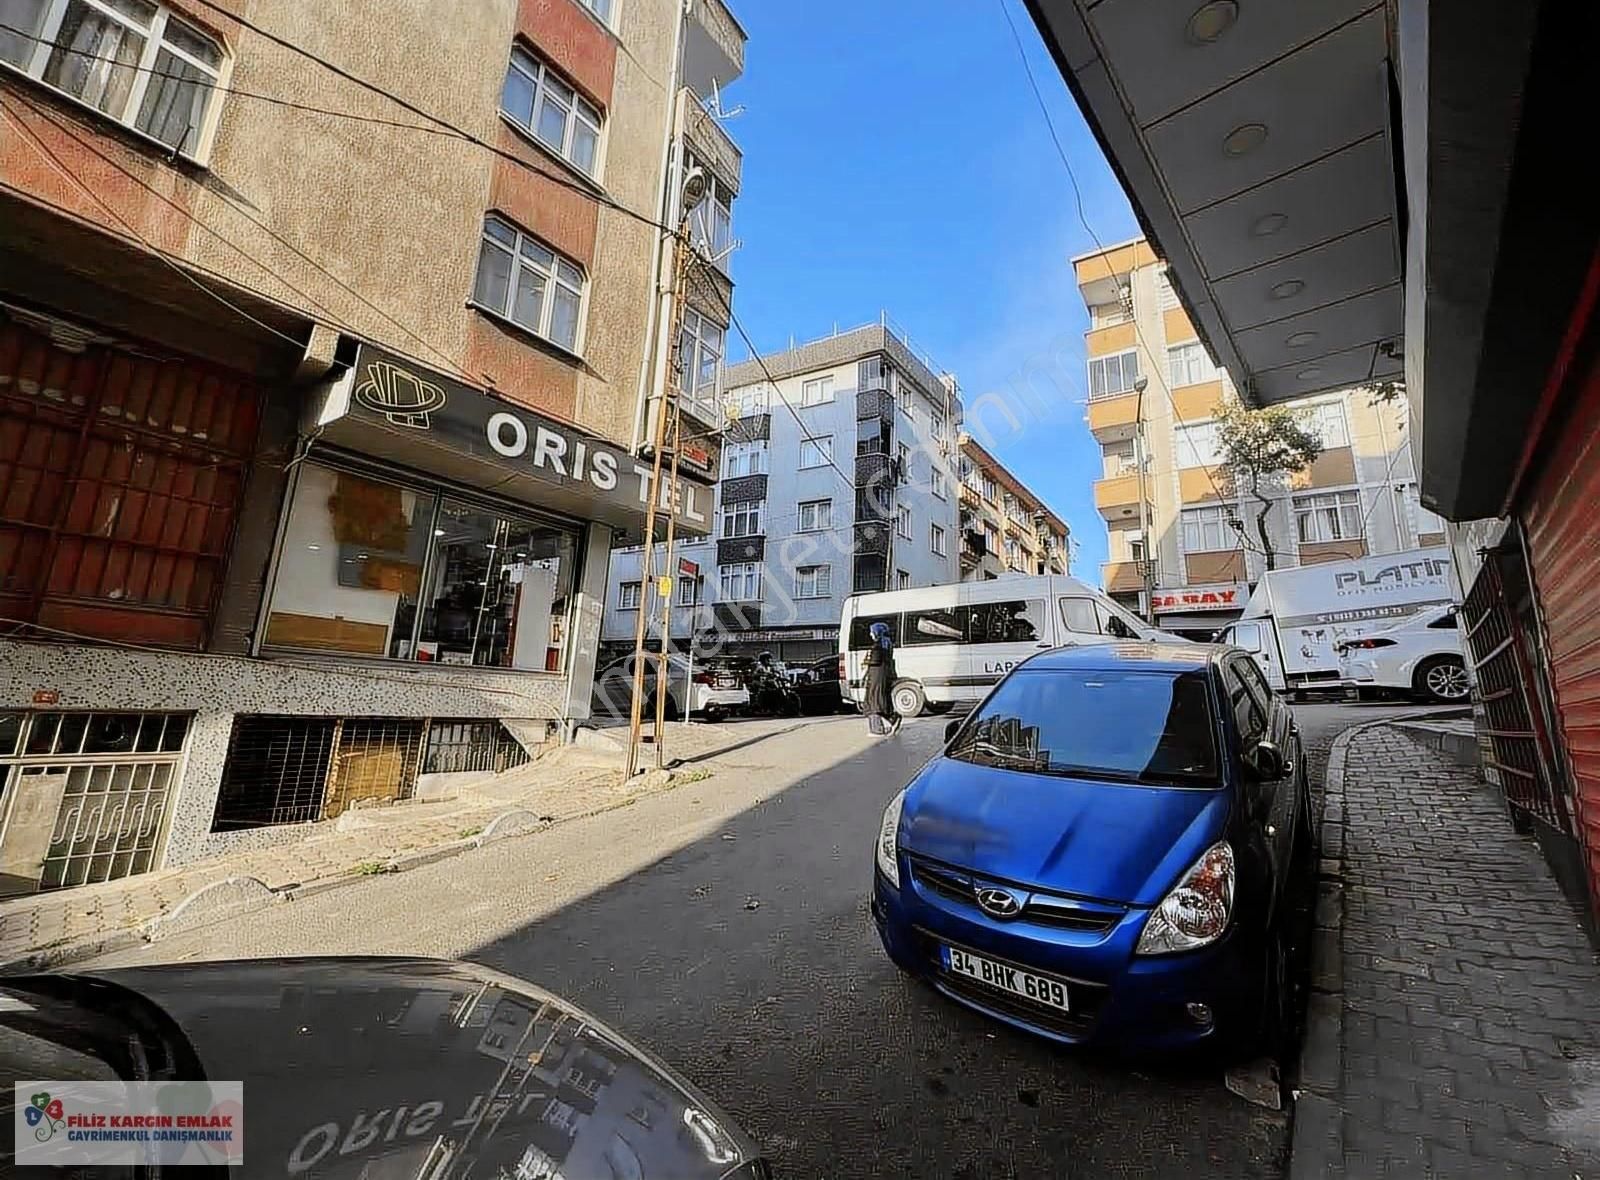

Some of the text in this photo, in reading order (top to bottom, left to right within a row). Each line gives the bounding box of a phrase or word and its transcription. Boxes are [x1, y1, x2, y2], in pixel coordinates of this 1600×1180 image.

[486, 412, 705, 522] ORIS TEL
[952, 951, 975, 975] 34
[980, 960, 1018, 991] BHK
[1024, 974, 1065, 1006] 689
